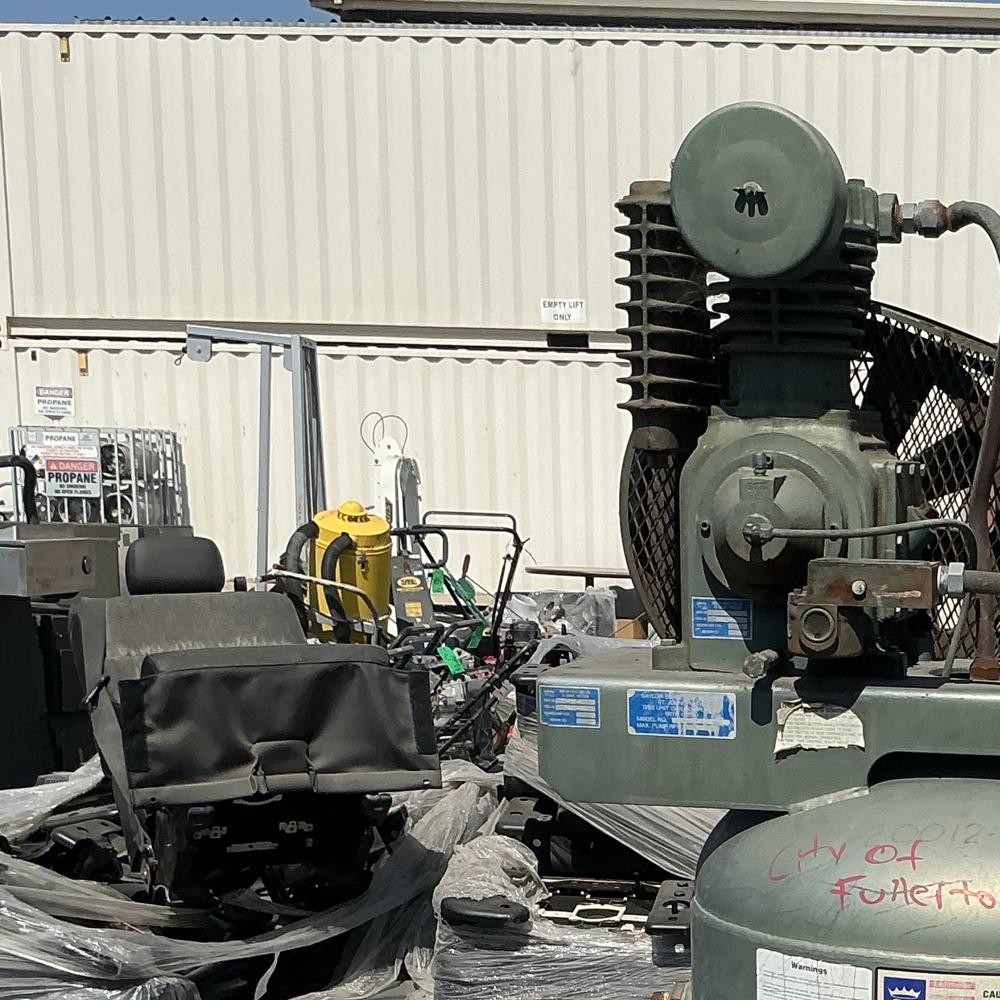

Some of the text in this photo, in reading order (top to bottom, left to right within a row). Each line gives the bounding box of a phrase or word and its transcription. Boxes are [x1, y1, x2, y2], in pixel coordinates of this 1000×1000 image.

[542, 301, 584, 309] EMPTY LIFT
[39, 387, 70, 397] DANGER
[45, 434, 76, 442] PROPANE
[59, 462, 95, 471] DANGER
[48, 472, 97, 483] PROPANE
[791, 961, 828, 976] Warnings
